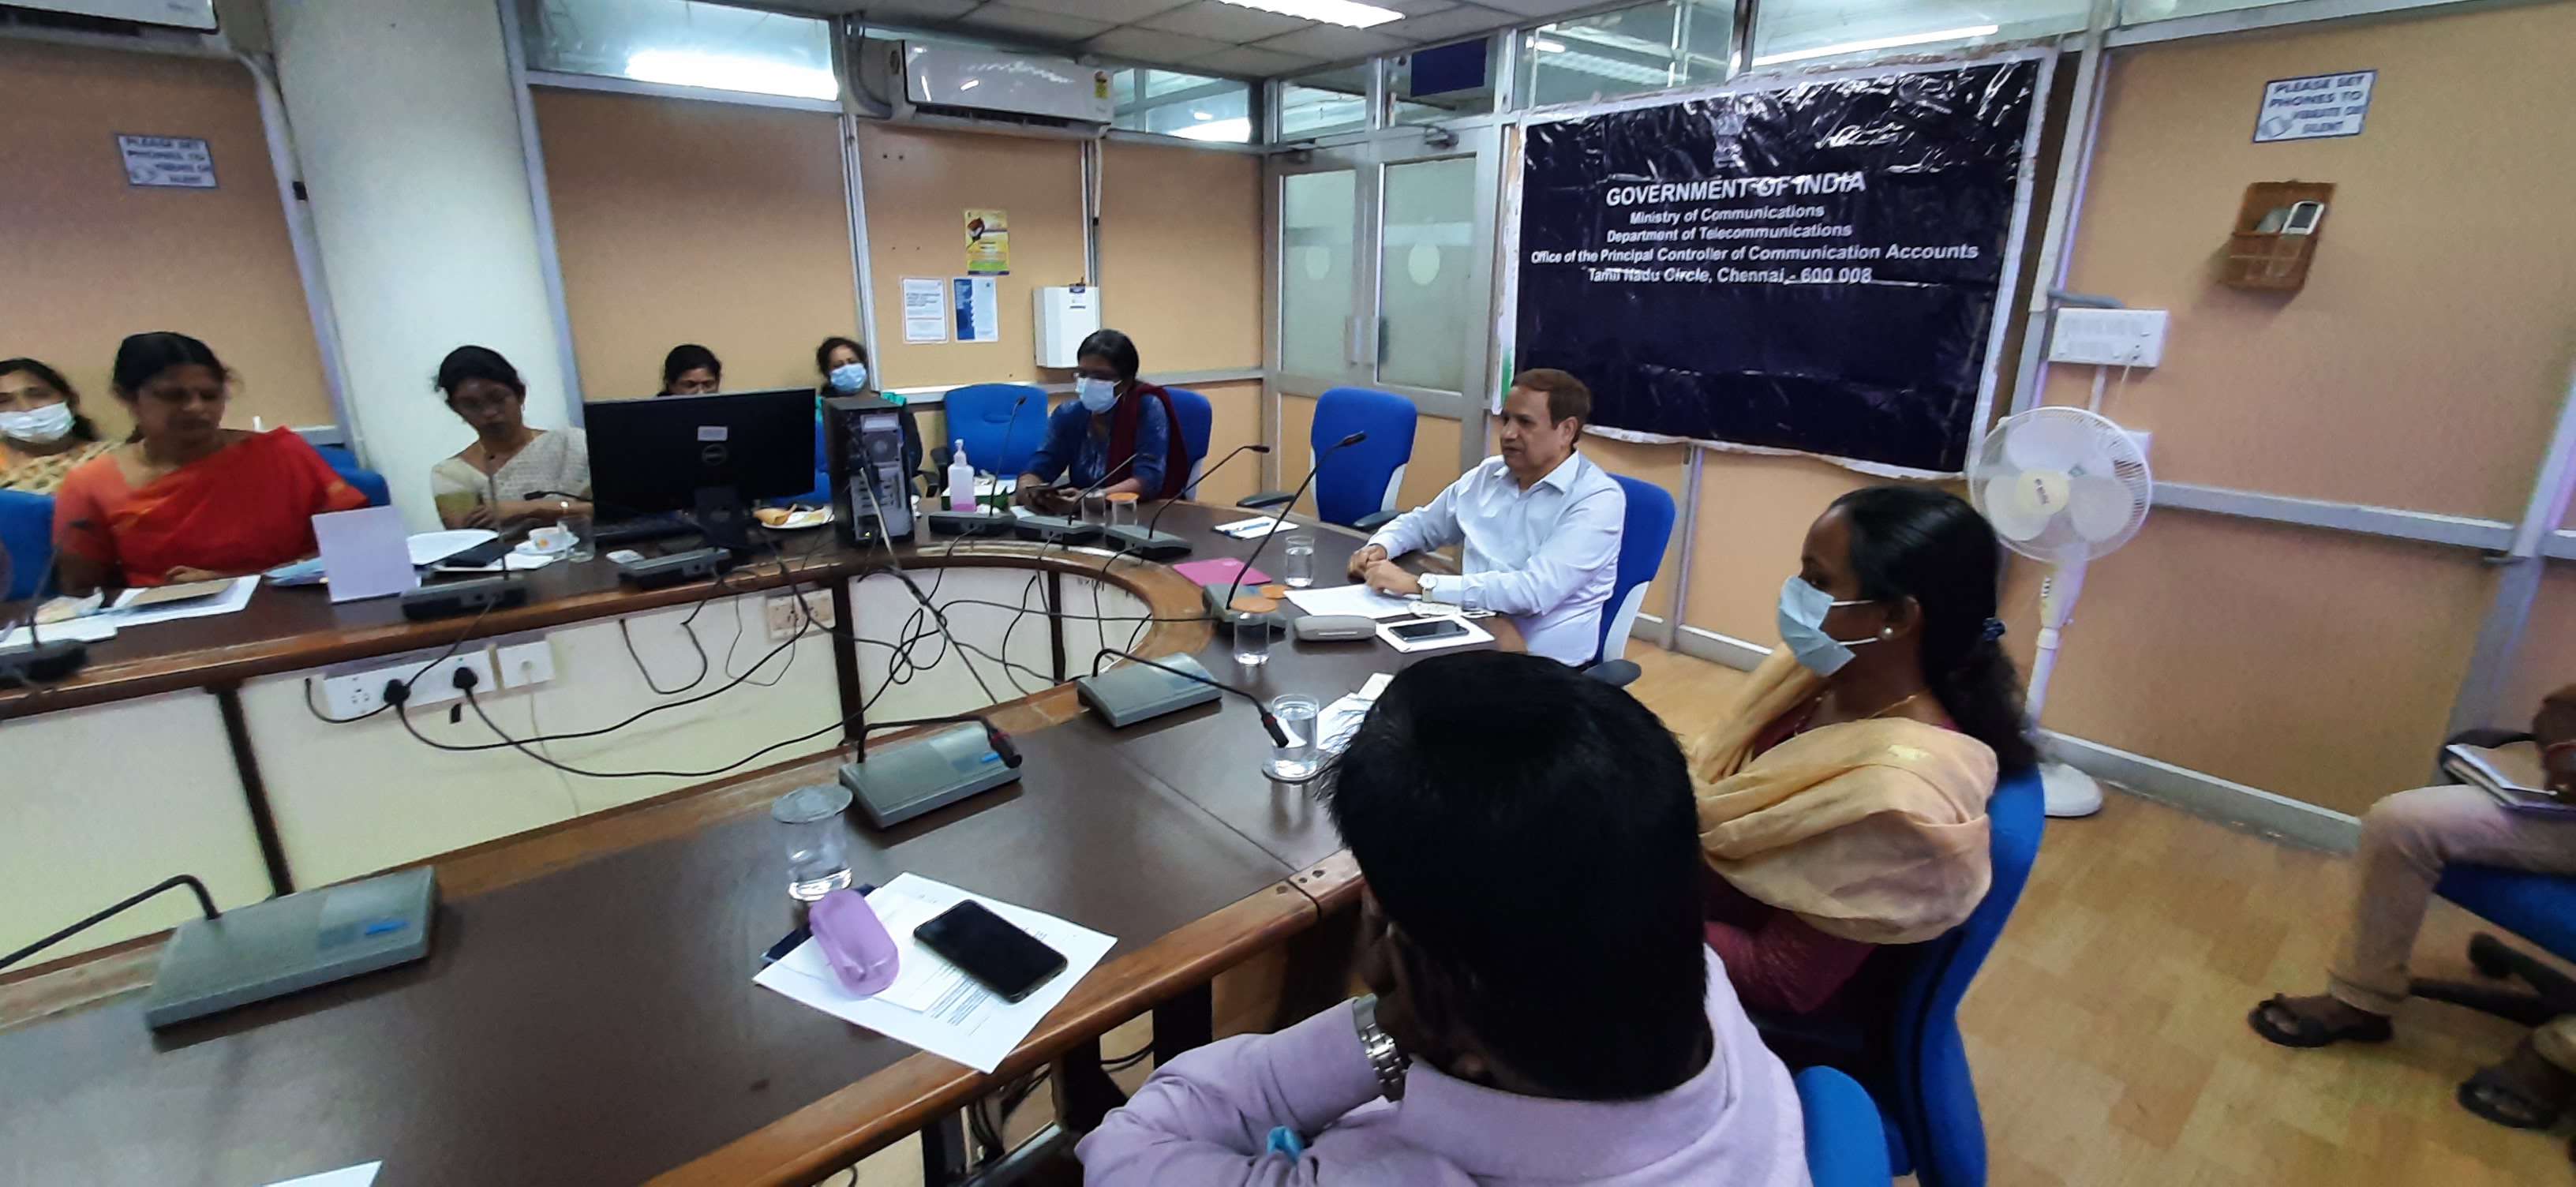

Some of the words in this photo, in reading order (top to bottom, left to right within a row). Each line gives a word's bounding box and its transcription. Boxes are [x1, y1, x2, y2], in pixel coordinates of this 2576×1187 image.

[2274, 80, 2331, 93] PLEASE
[2268, 92, 2335, 107] PHONES
[2341, 91, 2363, 100] TO
[1606, 178, 1751, 206] GOVERNMENT
[1756, 176, 1792, 197] OF
[1795, 171, 1866, 195] INDIA
[1630, 211, 1681, 226] Ministry
[1683, 209, 1698, 223] of
[1701, 204, 1825, 222] Communications
[1607, 227, 1679, 244] Department
[1681, 227, 1696, 241] of
[1700, 223, 1852, 241] Telecommunications
[1531, 250, 1562, 264] Office
[1563, 249, 1576, 263] of
[1578, 249, 1598, 262] the
[1600, 248, 1654, 264] Principal
[1657, 247, 1728, 262] Controller
[1731, 245, 1746, 260] of
[1748, 244, 1881, 260] Communication
[1885, 243, 1979, 260] Accounts
[1588, 268, 1619, 283] Tamil
[1623, 269, 1660, 283] Nadu
[1663, 267, 1713, 284] Circle,
[1801, 268, 1833, 283] 600
[1839, 268, 1874, 283] 008
